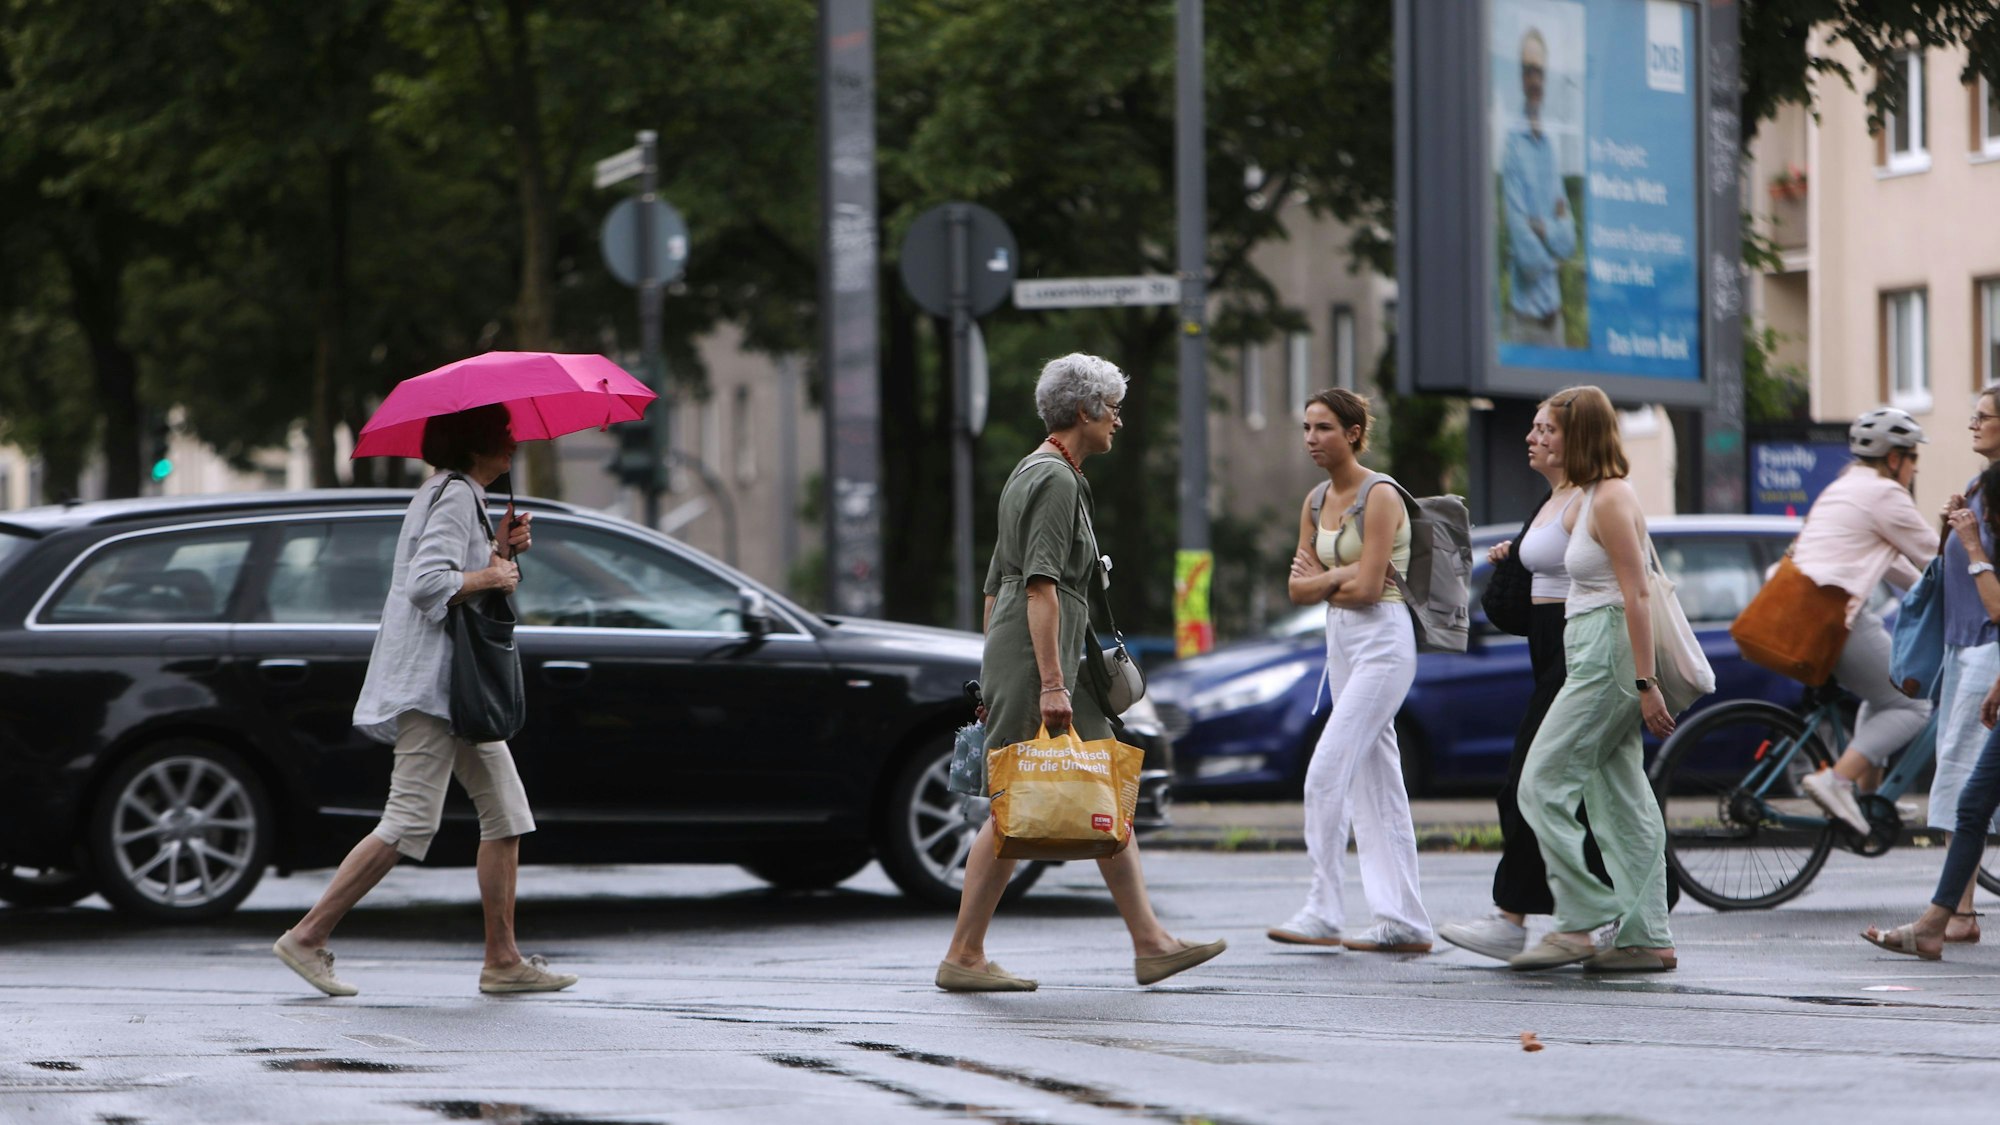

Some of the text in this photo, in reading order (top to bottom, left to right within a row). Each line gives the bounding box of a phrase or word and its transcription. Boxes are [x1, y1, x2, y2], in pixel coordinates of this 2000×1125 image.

[1758, 445, 1816, 472] Family
[1758, 467, 1802, 489] Club
[1018, 760, 1109, 776] für die Umwelt.
